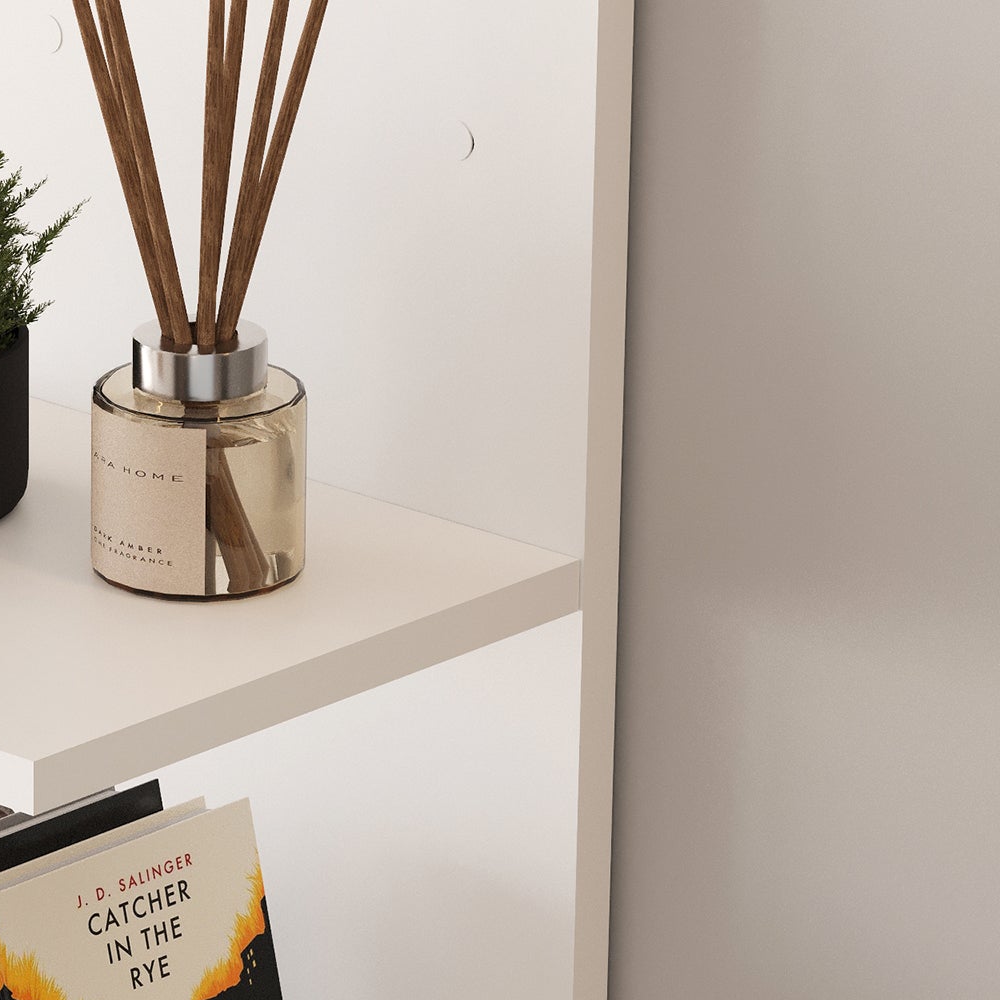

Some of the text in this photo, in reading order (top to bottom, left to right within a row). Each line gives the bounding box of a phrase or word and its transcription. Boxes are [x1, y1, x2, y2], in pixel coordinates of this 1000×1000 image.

[123, 466, 184, 482] HOME
[119, 540, 162, 555] AMBER
[77, 853, 193, 908] J. D. SALINGER
[88, 879, 192, 935] CATCHER
[106, 916, 183, 964] IN THE
[130, 955, 171, 990] RYE
